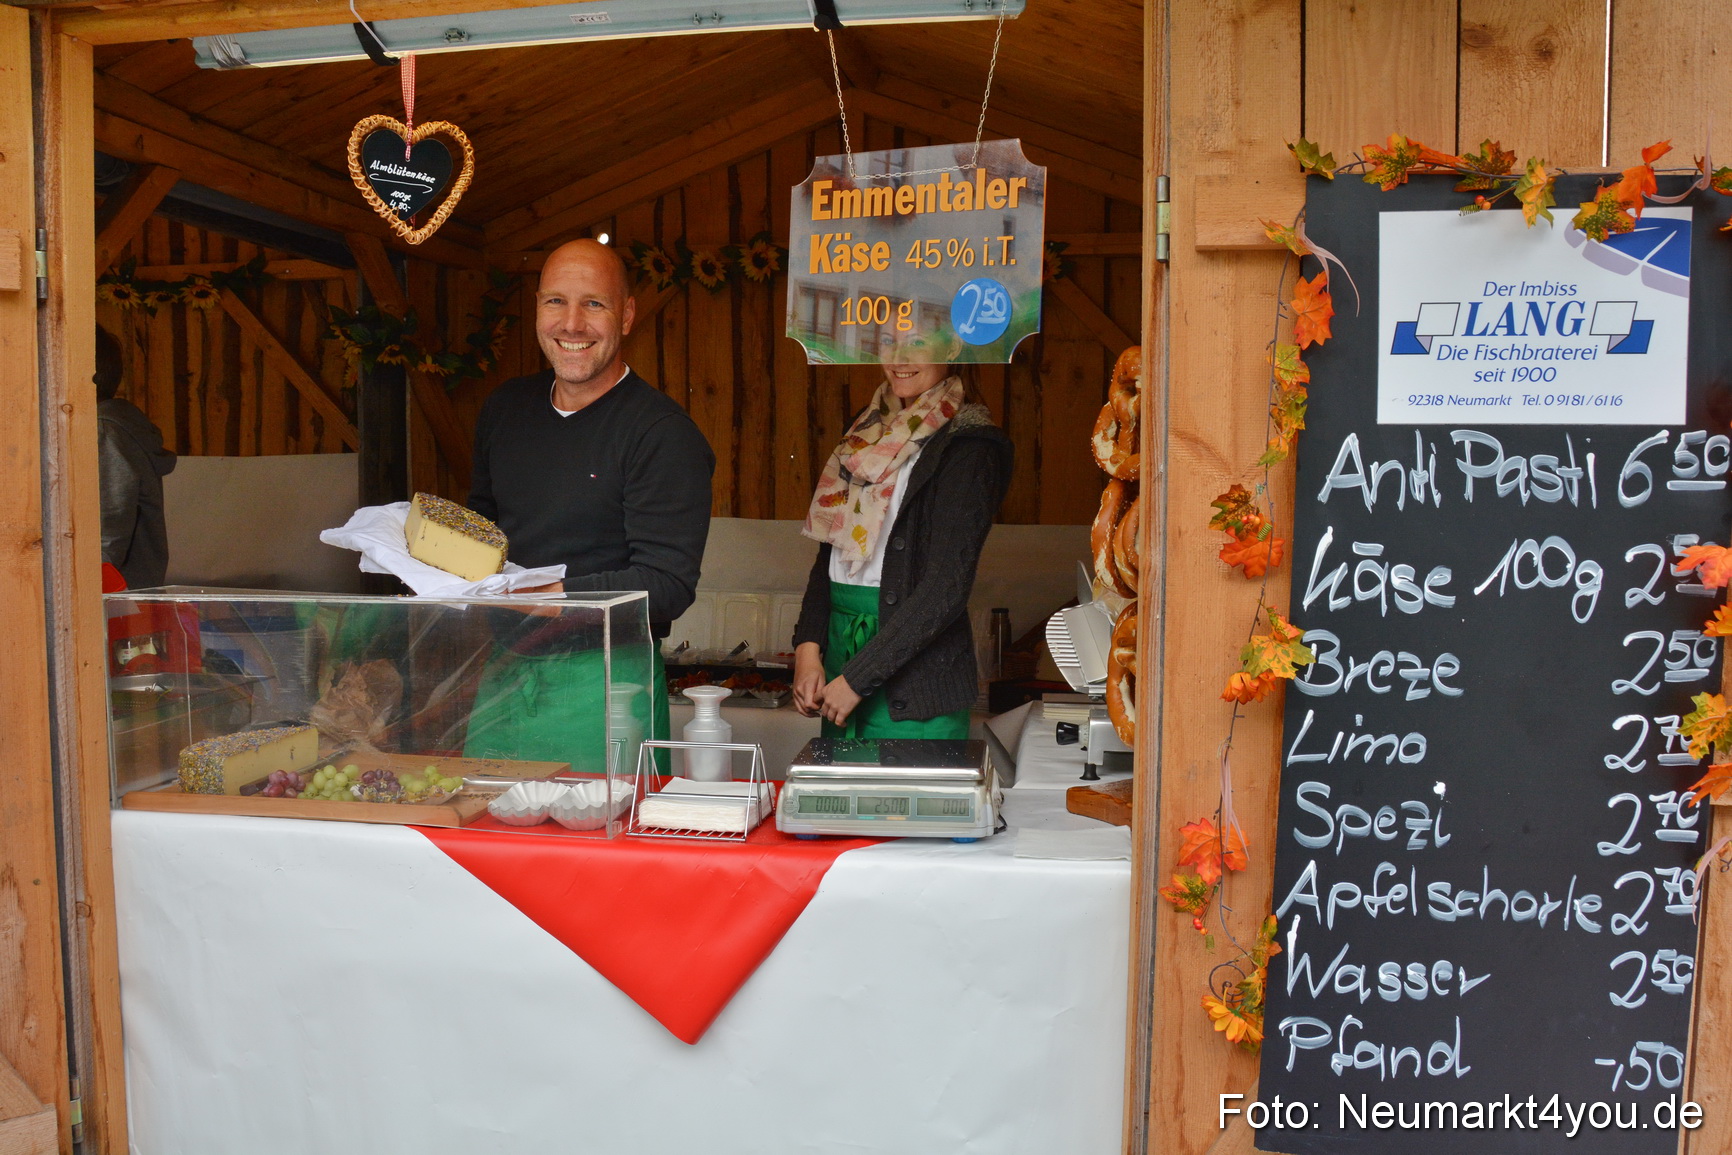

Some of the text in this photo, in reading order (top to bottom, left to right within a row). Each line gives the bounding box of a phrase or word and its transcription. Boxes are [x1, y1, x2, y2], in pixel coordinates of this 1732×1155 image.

[811, 168, 1027, 221] Emmentaler
[809, 232, 891, 274] Käse
[840, 295, 914, 331] 100 g
[1483, 281, 1578, 297] Der Imbiss
[1461, 300, 1587, 337] LANG
[1436, 344, 1599, 361] Die Fischbraterei
[1473, 367, 1557, 383] seit 1900
[1408, 394, 1445, 406] 92318
[1447, 394, 1513, 406] Neumarkt
[1522, 394, 1541, 406] Tel.
[1318, 429, 1441, 513] Anti
[1450, 429, 1597, 508] Pasti
[1303, 526, 1457, 617] Käse
[1294, 629, 1465, 701] Breze
[1286, 709, 1428, 767] Limo
[1292, 780, 1452, 856] Spezi
[1286, 914, 1491, 1004] Wasser
[1279, 1014, 1472, 1082] Pfand
